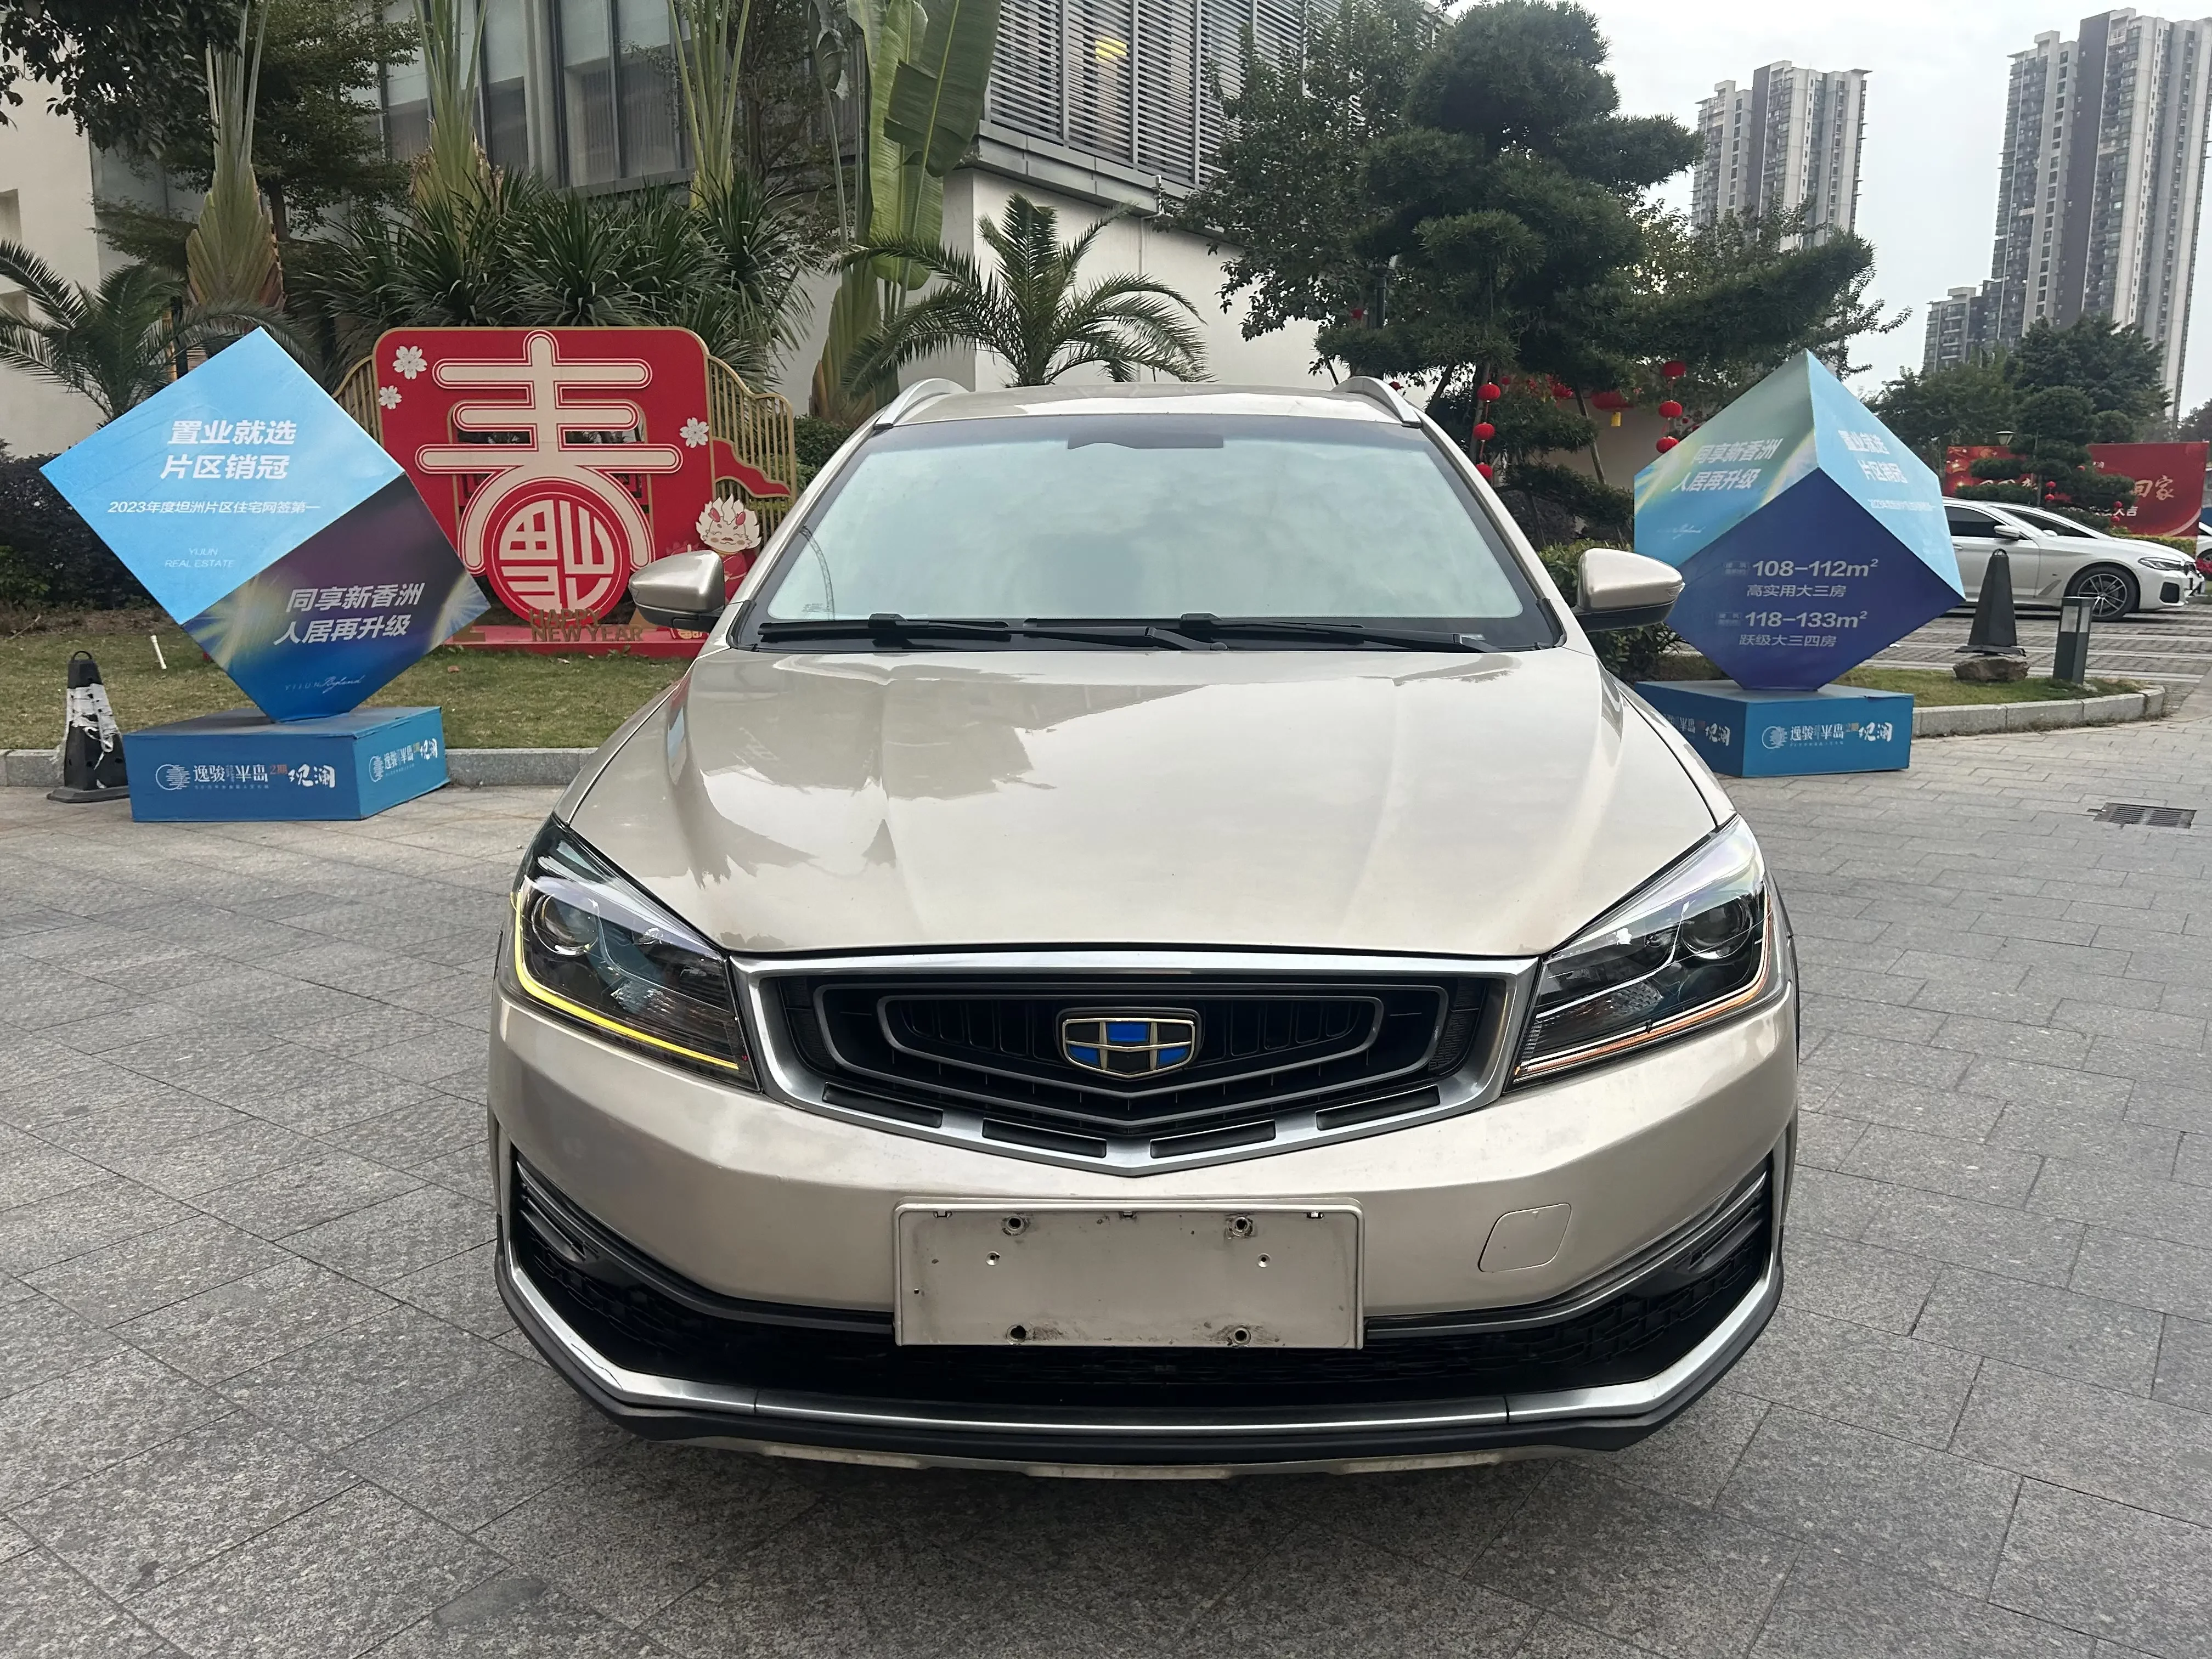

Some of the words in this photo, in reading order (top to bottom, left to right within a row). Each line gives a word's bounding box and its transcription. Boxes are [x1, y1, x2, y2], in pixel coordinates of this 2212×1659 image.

[167, 420, 297, 445] 置业就选
[1691, 438, 1784, 464] 同享新香洲
[160, 454, 290, 479] 片区销冠
[1671, 469, 1761, 492] 人居再升级
[108, 501, 321, 514] 2023年度坦洲片区住宅网签第一
[285, 583, 425, 613] 同享新香洲
[1746, 584, 1847, 597] 高实用大三房
[273, 614, 411, 645] 人居再升级
[529, 608, 602, 628] HAPPY
[531, 625, 582, 642] NEW
[584, 624, 644, 642] YEAR
[1739, 634, 1837, 647] 跃级大三四房
